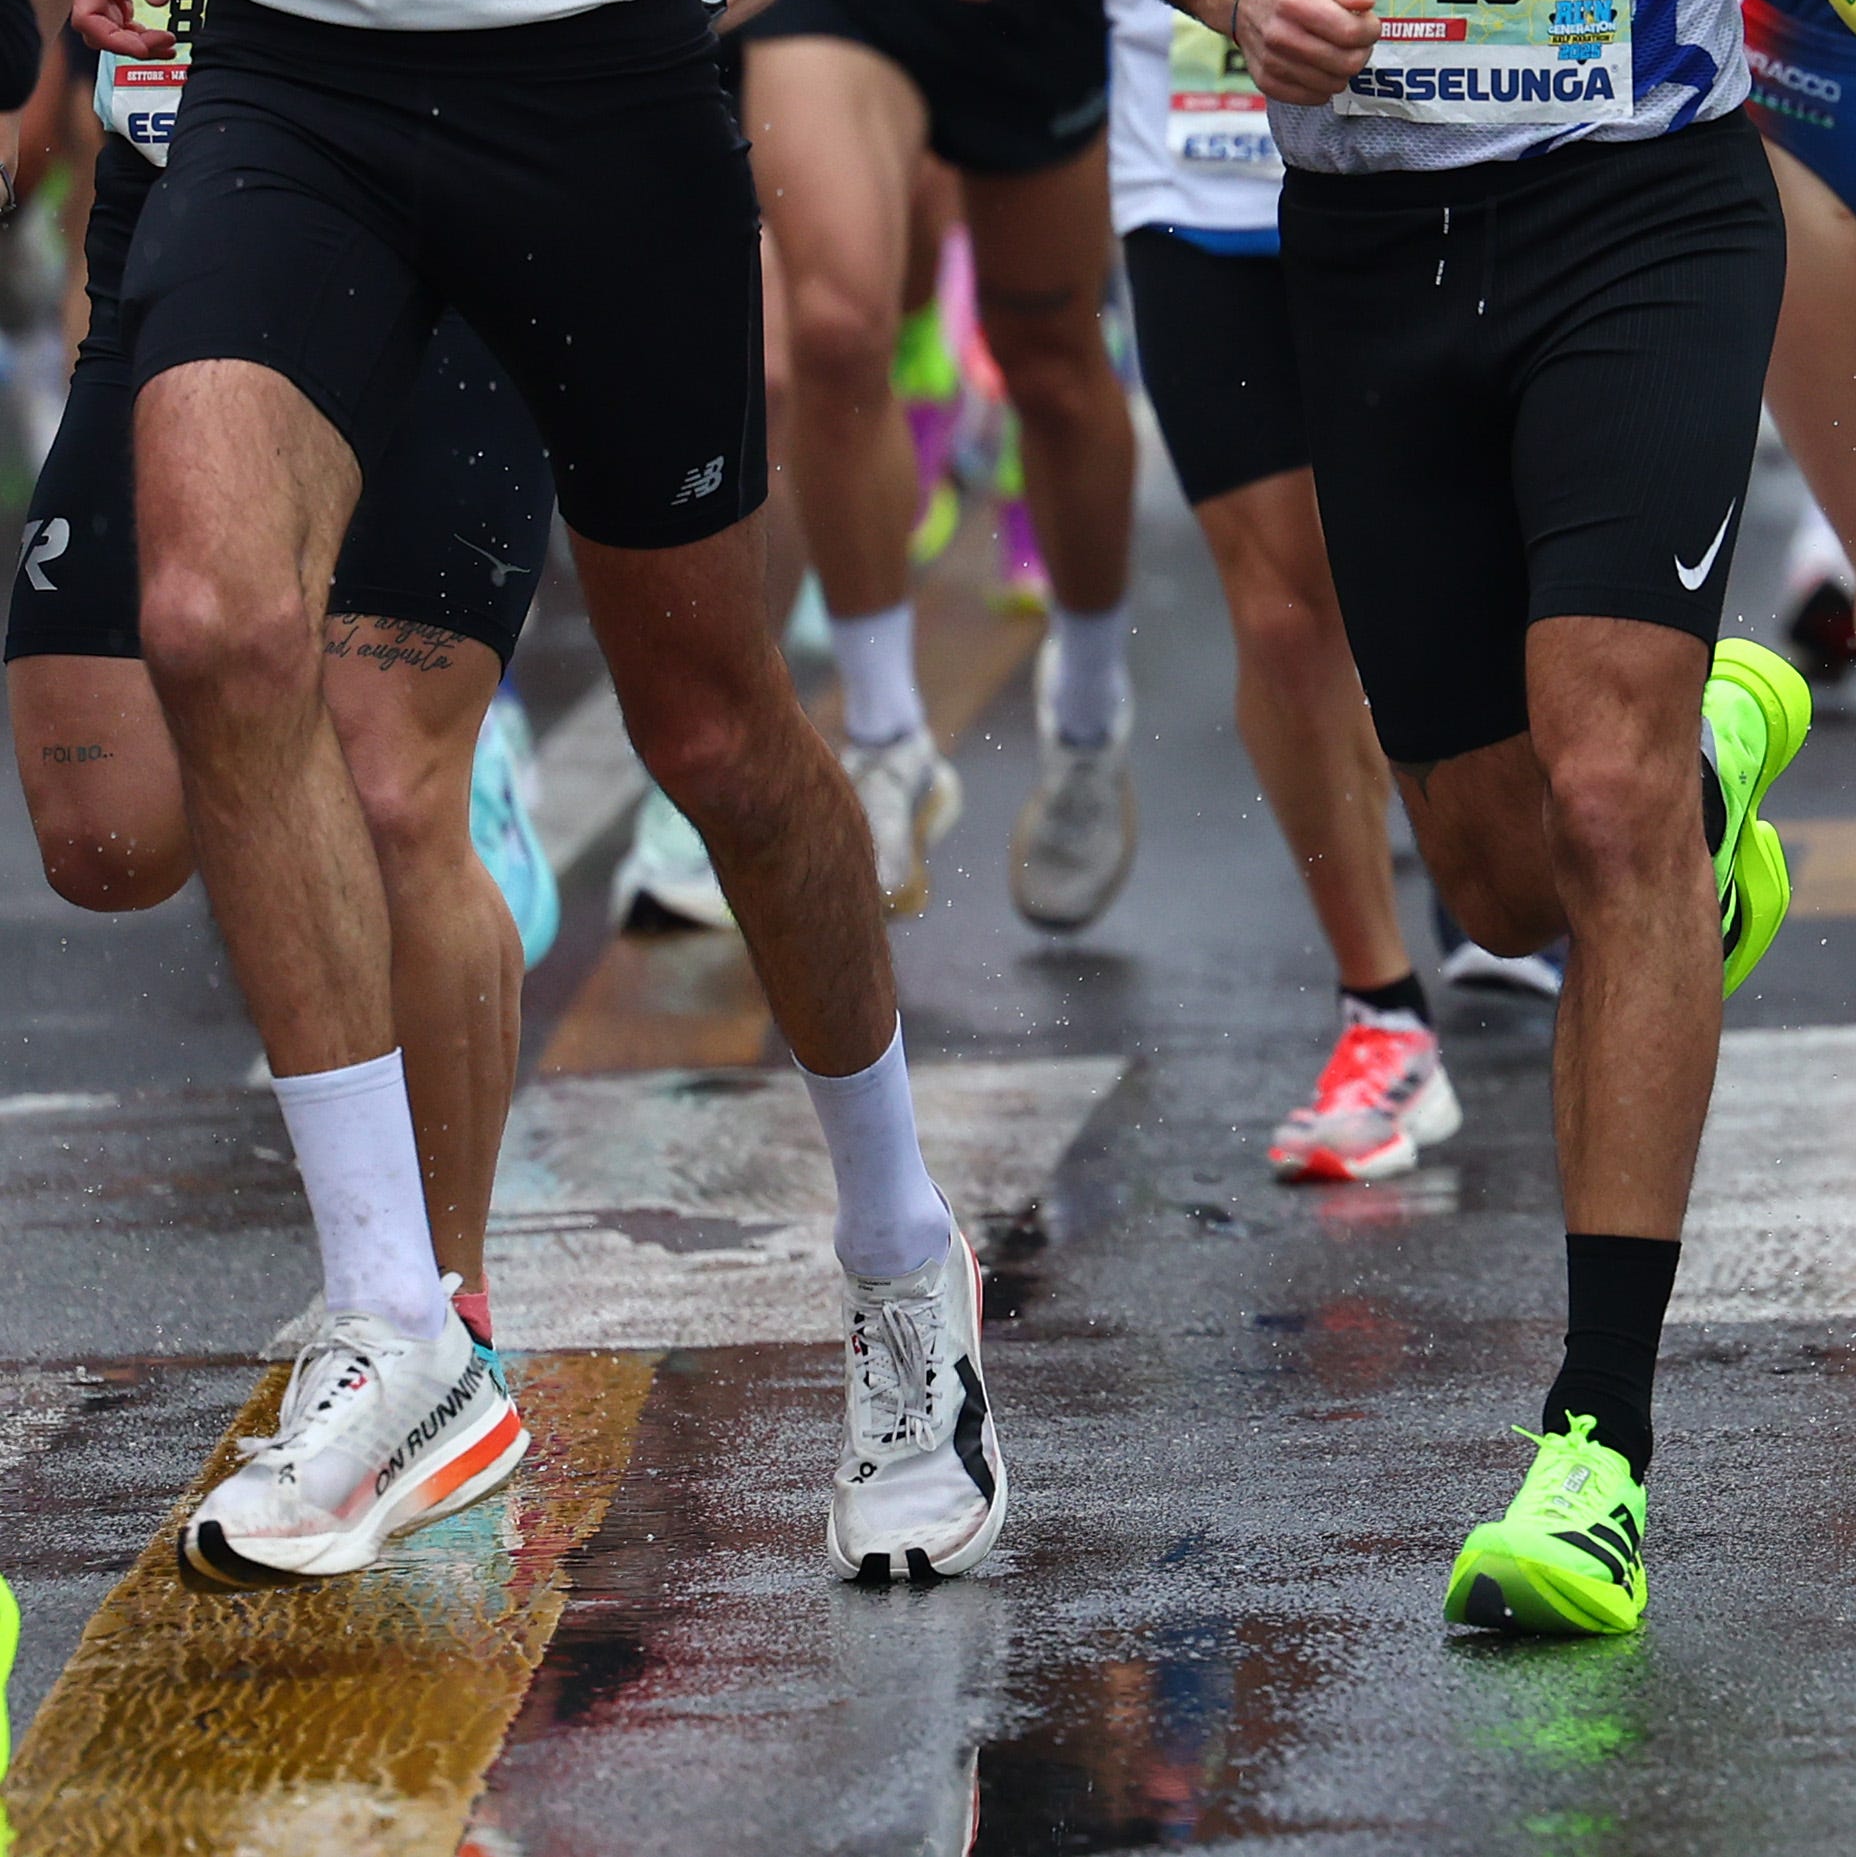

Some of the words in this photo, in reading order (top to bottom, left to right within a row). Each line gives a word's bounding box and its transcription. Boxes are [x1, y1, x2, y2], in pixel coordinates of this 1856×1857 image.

[1381, 22, 1447, 38] RUNNER
[126, 70, 164, 81] SETTORE
[1349, 67, 1615, 102] ESSELUNGA
[356, 641, 455, 672] augusta
[375, 1442, 406, 1498] ON
